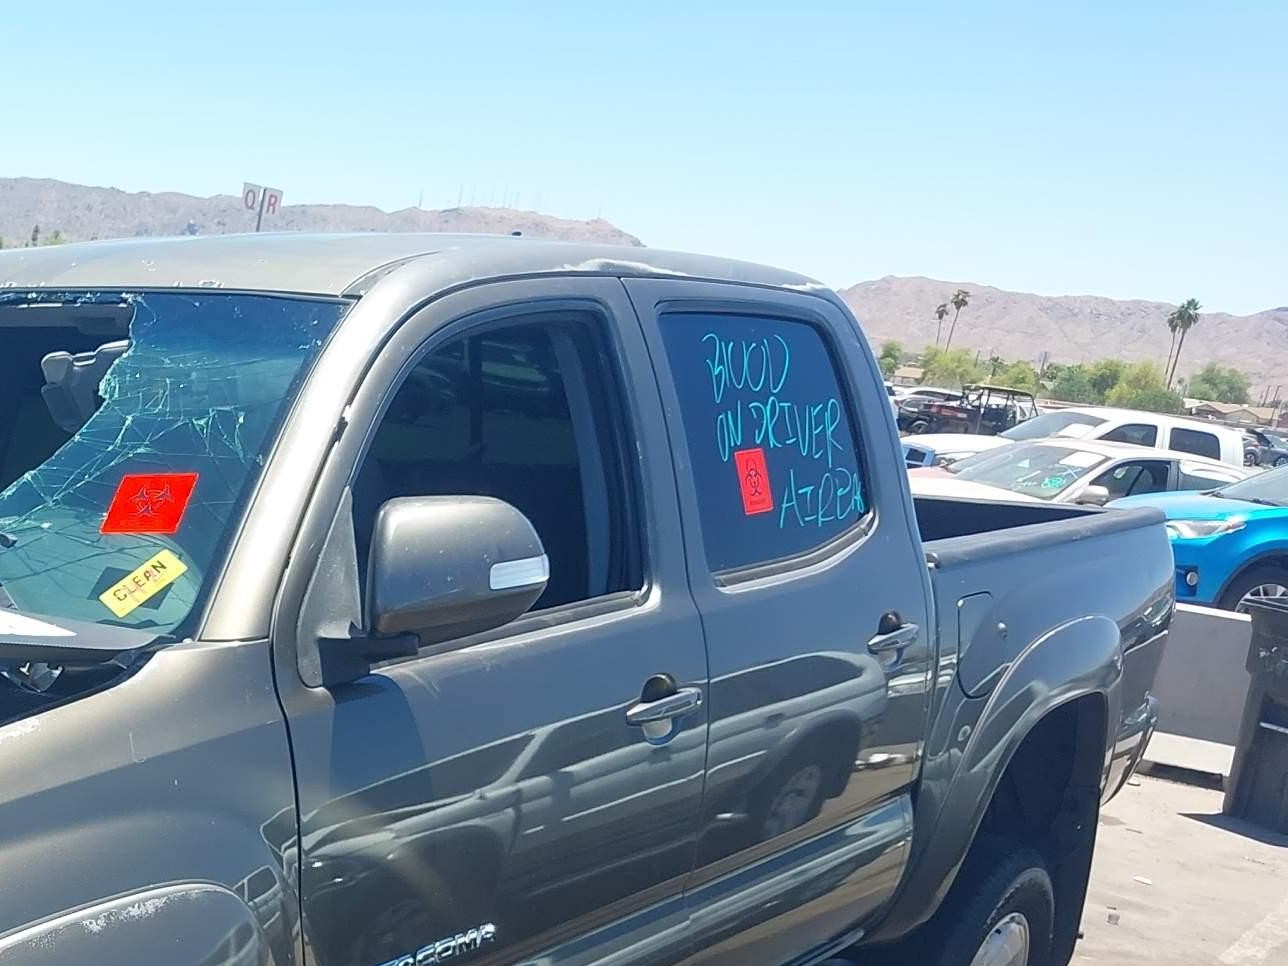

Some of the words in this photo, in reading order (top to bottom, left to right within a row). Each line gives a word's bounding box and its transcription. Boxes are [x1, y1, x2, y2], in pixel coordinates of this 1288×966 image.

[265, 193, 279, 216] R
[749, 396, 844, 468] DRIVER
[112, 560, 168, 602] CLEAN
